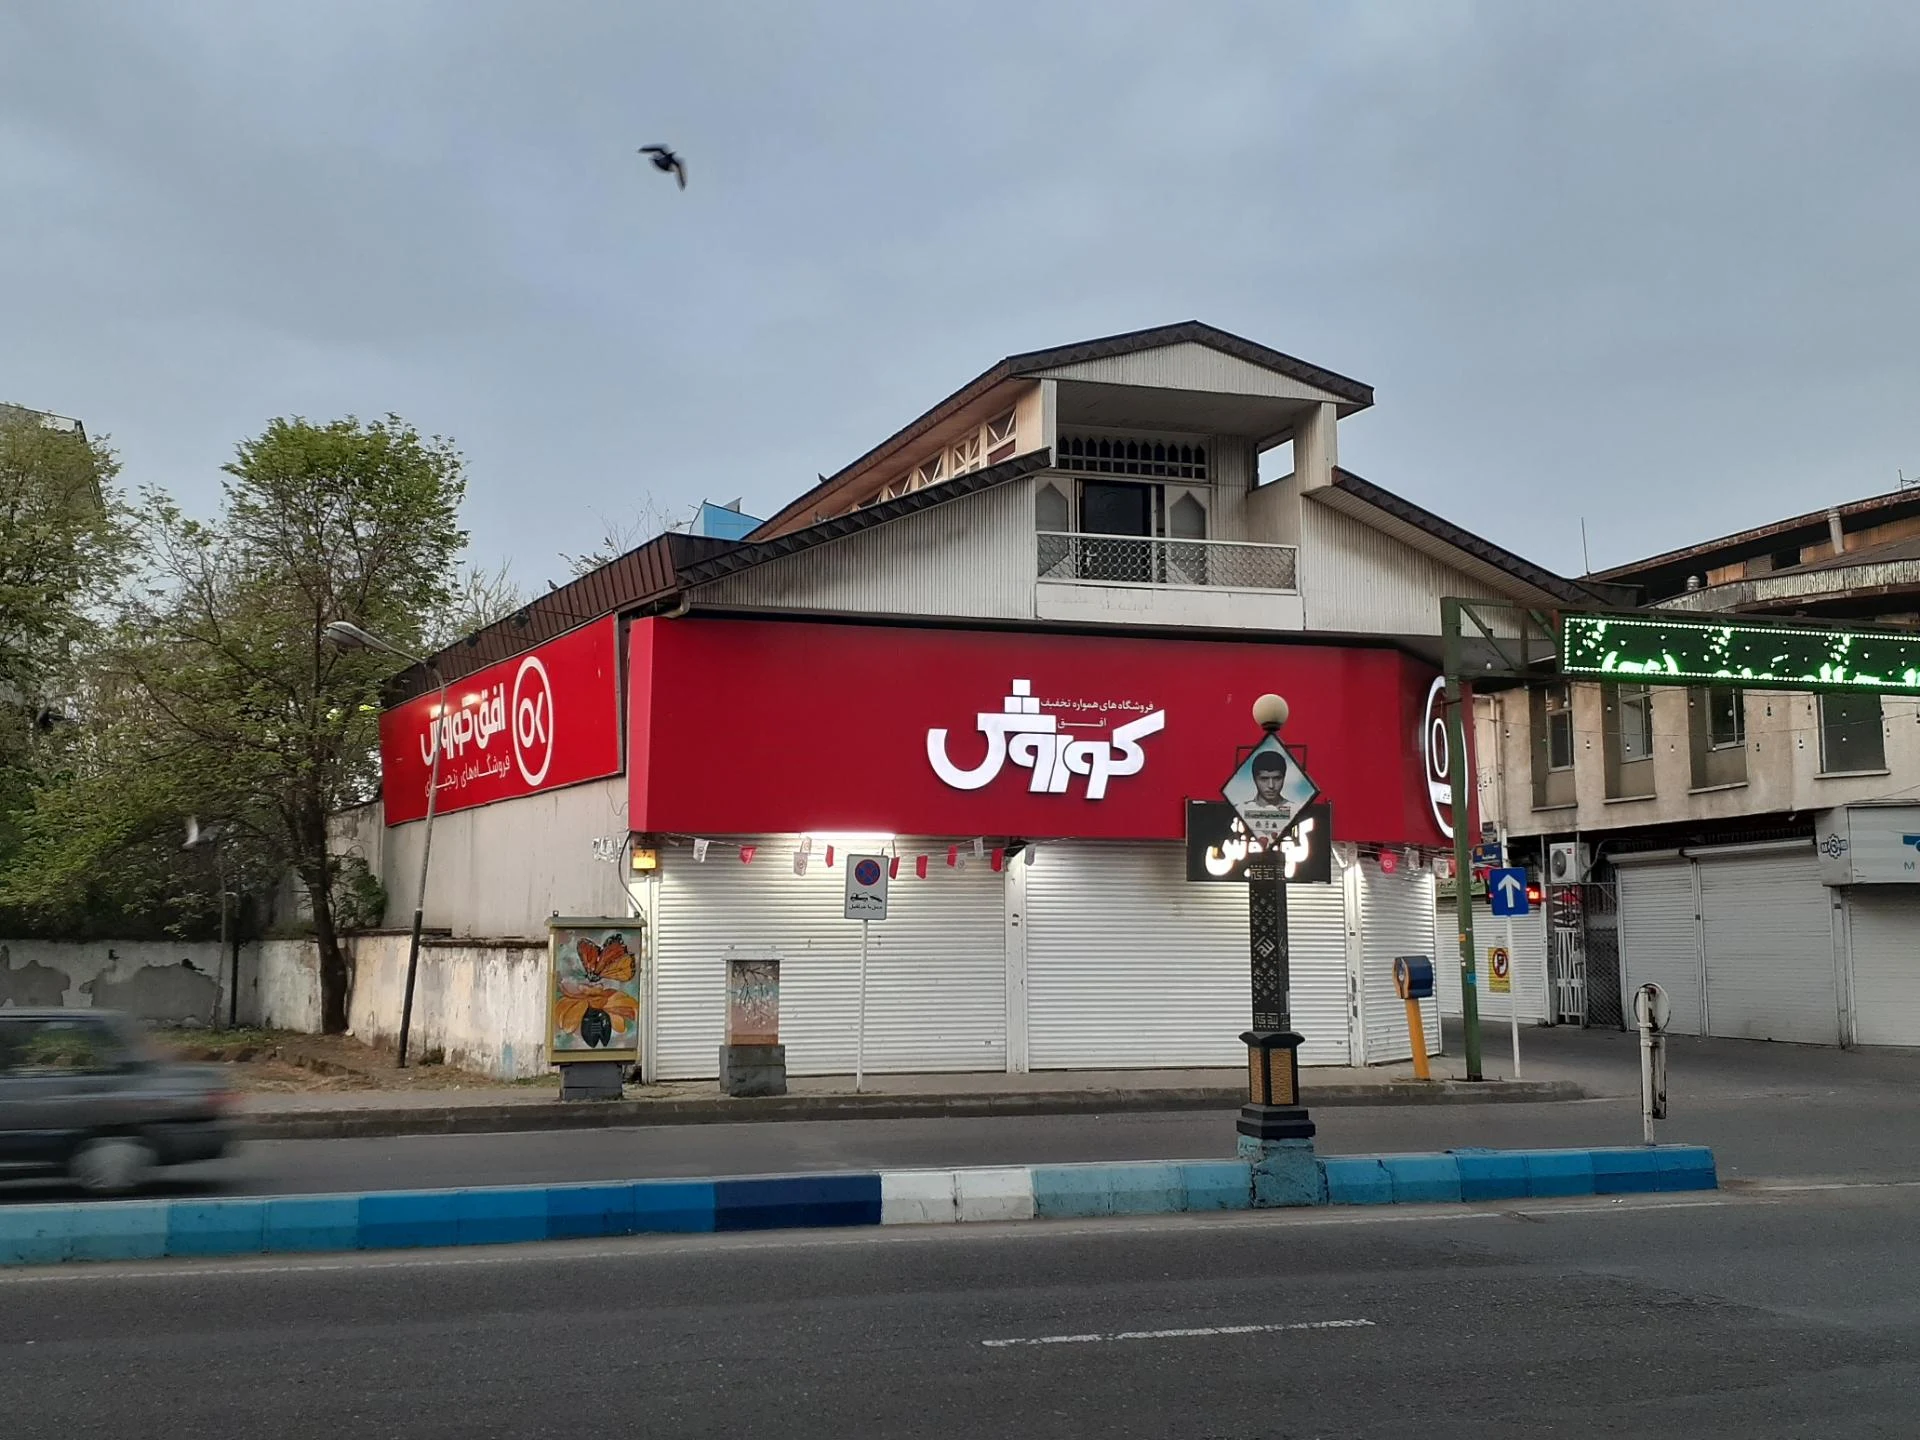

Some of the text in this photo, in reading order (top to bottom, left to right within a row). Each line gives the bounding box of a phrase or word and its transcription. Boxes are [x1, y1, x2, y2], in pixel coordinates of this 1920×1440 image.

[473, 682, 506, 749] افق
[1040, 698, 1154, 713] فروشگاه های همواره تخفیف
[1057, 718, 1107, 729] افق
[927, 679, 1165, 800] کوروش
